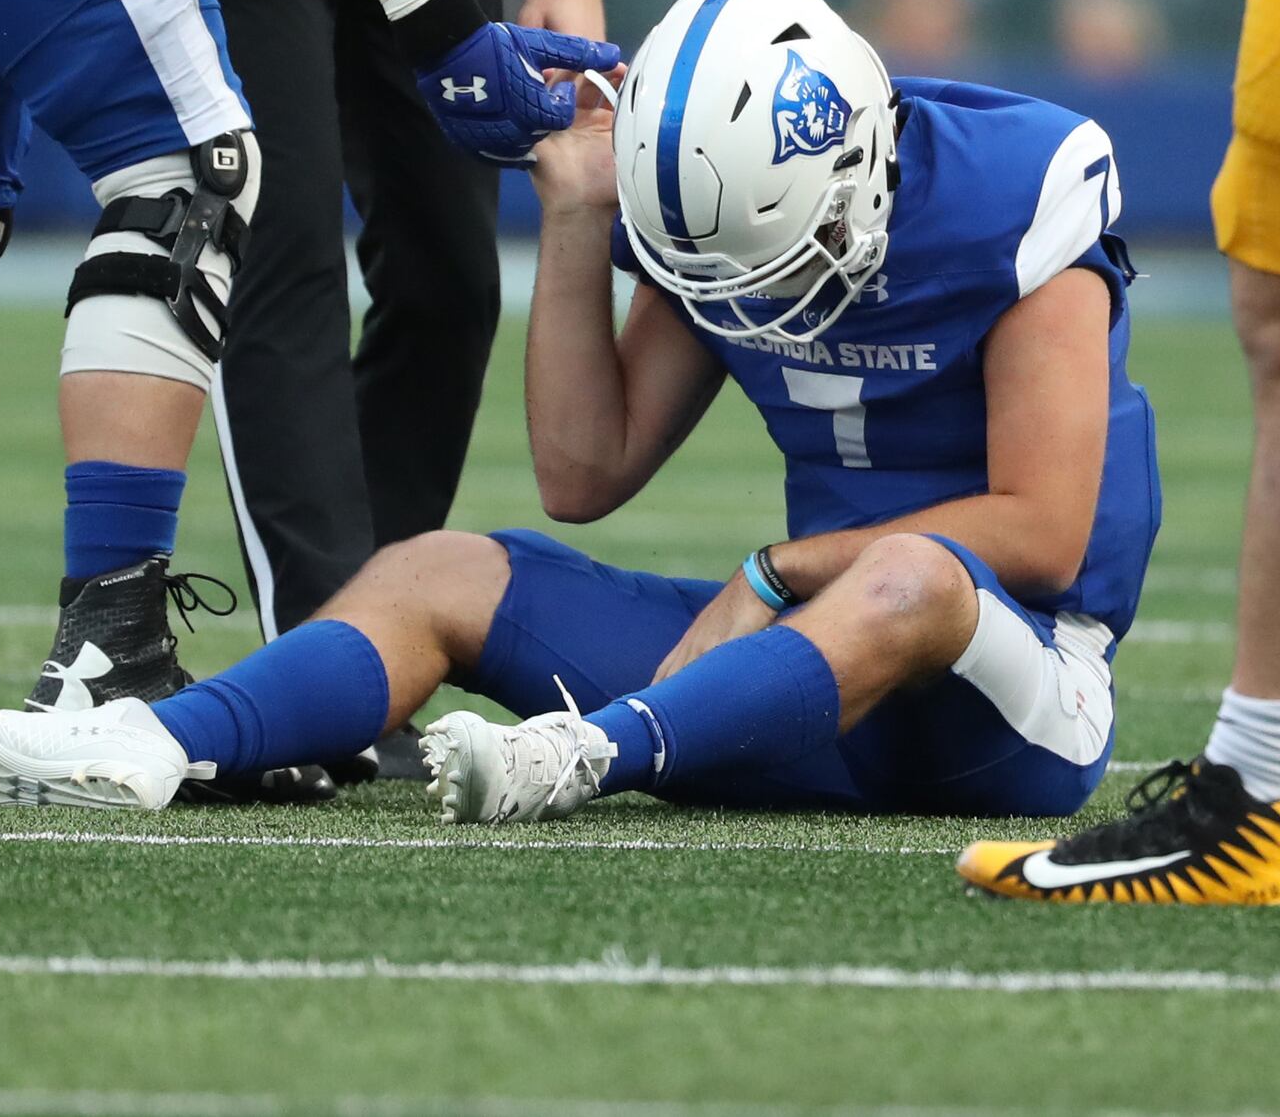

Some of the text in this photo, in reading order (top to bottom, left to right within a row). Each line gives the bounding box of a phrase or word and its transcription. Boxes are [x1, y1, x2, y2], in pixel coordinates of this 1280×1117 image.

[1083, 153, 1111, 236] 7
[838, 343, 937, 371] STATE
[781, 365, 872, 469] 7
